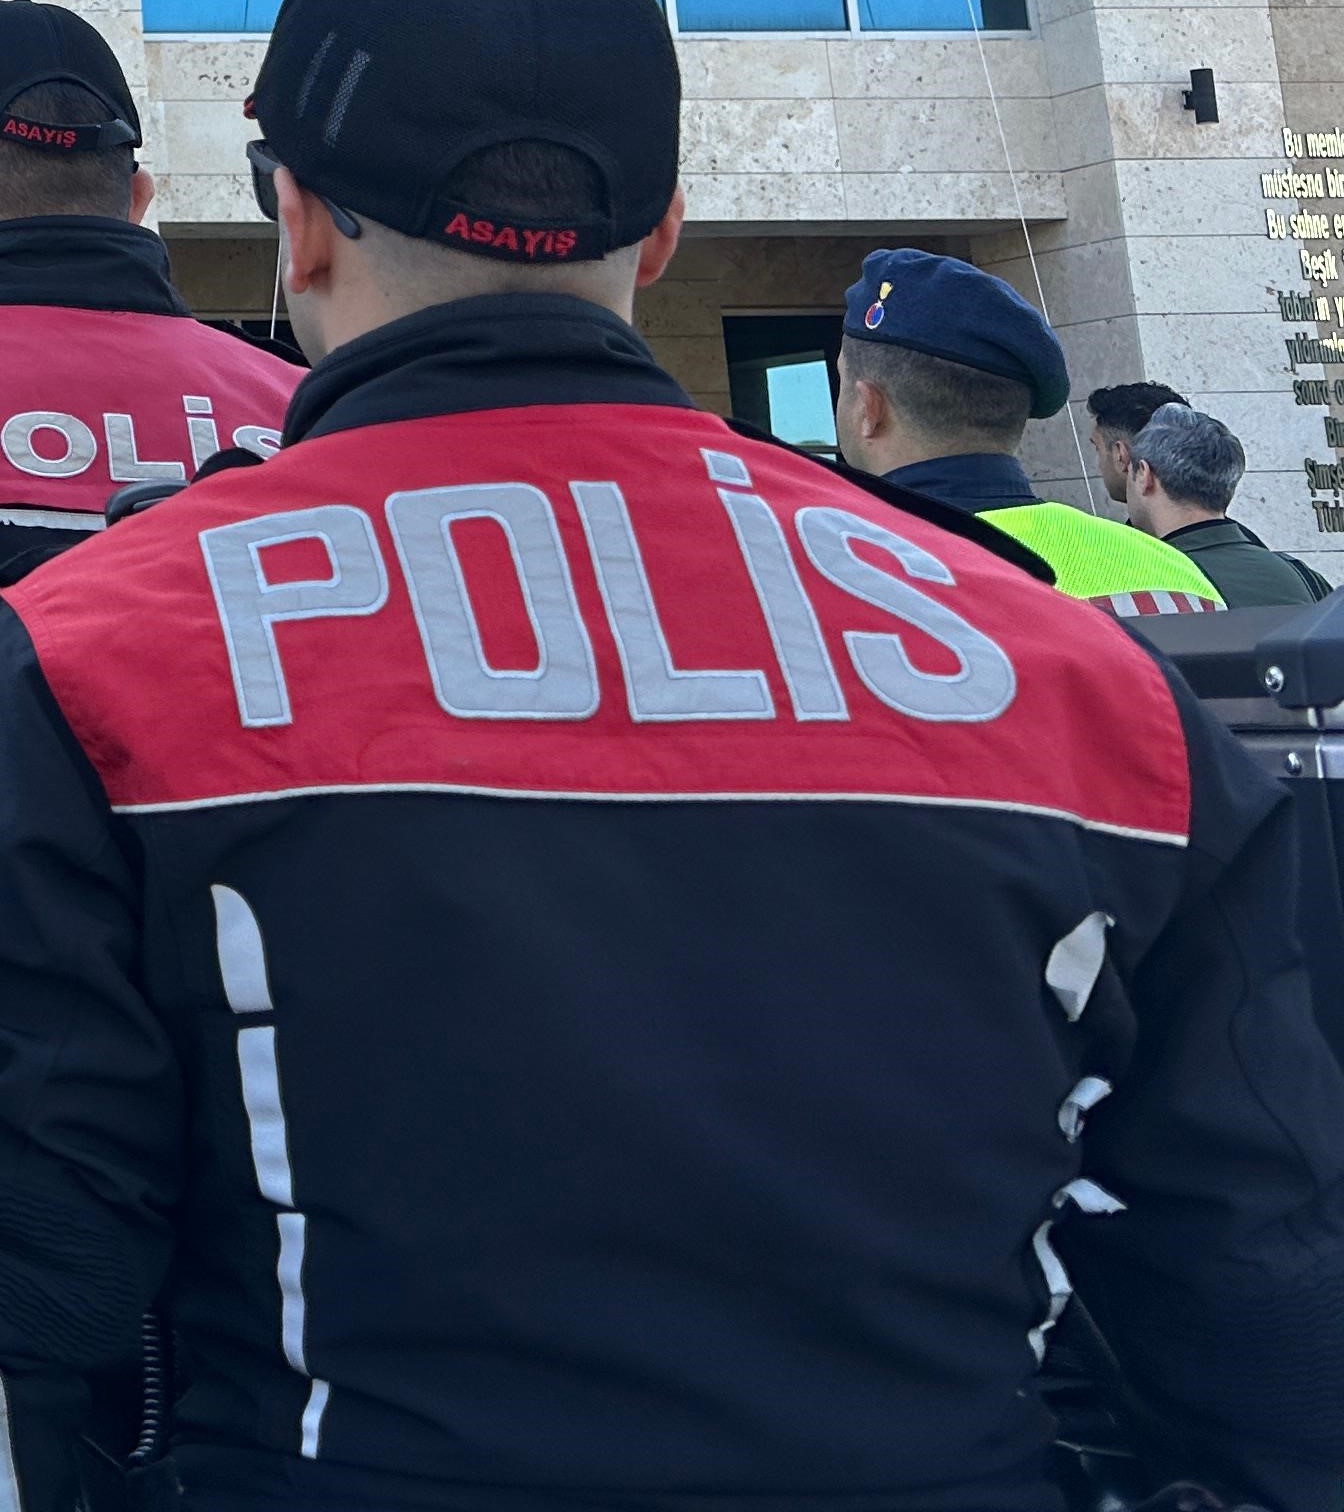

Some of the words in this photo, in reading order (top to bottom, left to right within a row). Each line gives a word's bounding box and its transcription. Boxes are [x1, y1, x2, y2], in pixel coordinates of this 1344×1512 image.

[2, 115, 79, 150] ASAYİŞ
[1281, 127, 1303, 158] Bu
[1260, 167, 1325, 199] müstesna
[442, 210, 579, 259] ASAYİŞ
[1265, 208, 1287, 240] Bu
[1289, 208, 1330, 240] sahne
[1299, 248, 1339, 288] Beşik
[197, 447, 1017, 729] POLİS
